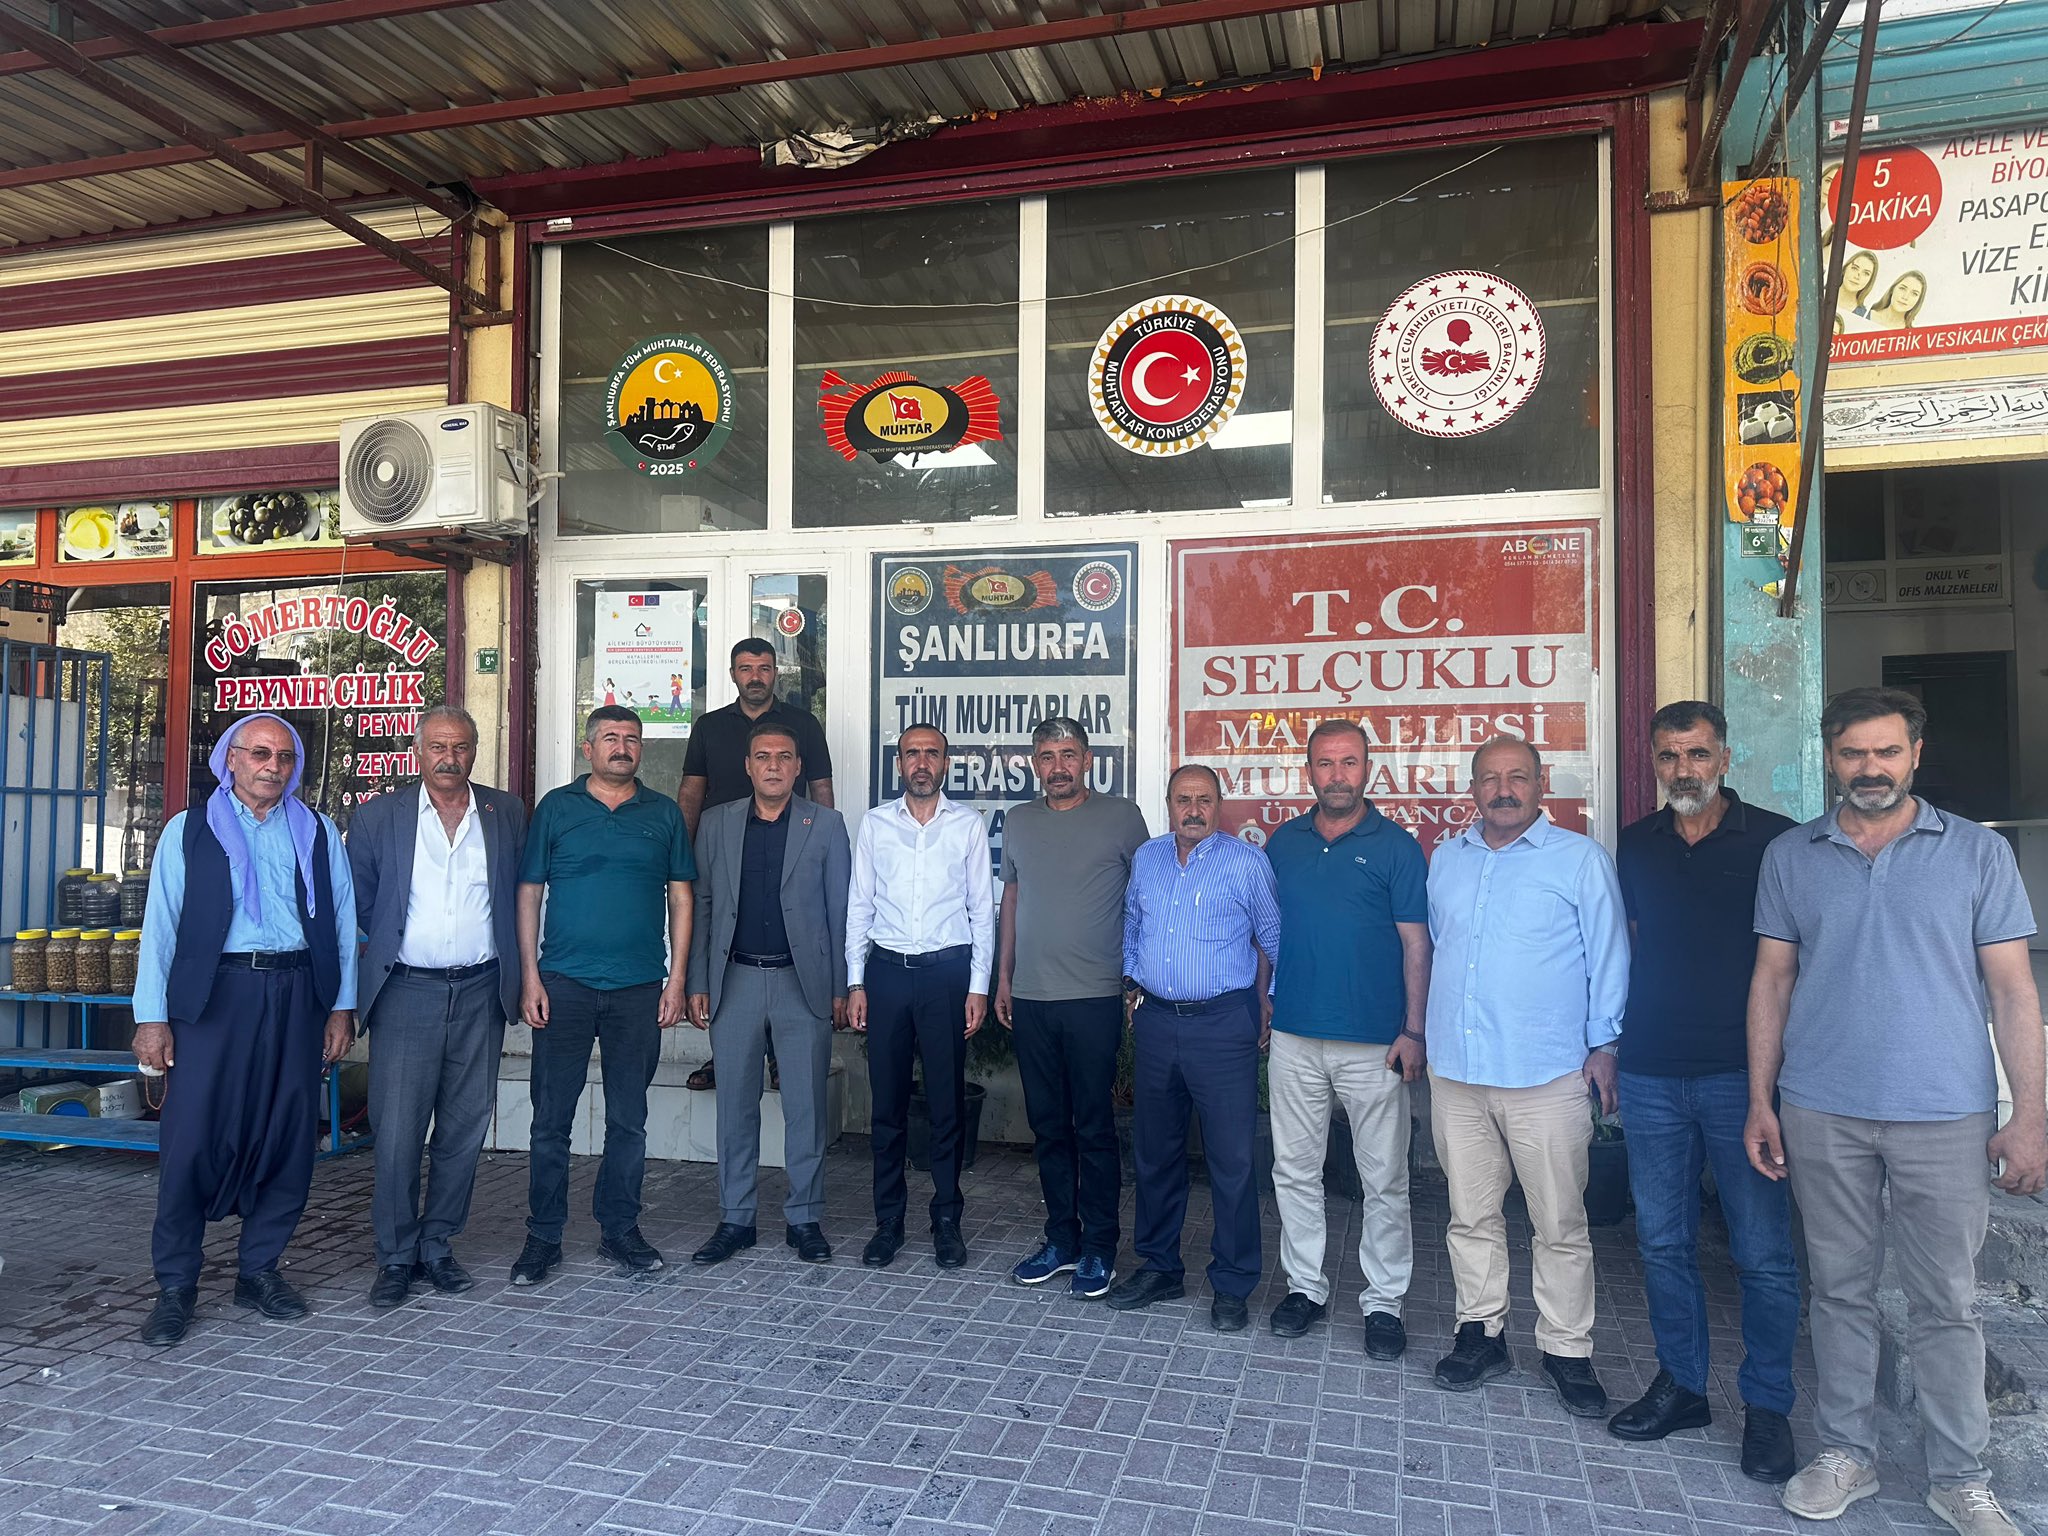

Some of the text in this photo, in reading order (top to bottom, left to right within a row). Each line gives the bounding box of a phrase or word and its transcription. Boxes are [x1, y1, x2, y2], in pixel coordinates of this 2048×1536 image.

[1942, 131, 2016, 160] ACELE
[1873, 158, 1893, 188] 5
[1991, 156, 2048, 184] BİYO
[1848, 192, 1933, 226] DAKİKA
[2029, 223, 2048, 250] E
[1962, 242, 2021, 276] VİZE
[1134, 314, 1197, 337] TÜRKİYE
[1401, 300, 1512, 401] TÜRKİYE CUMHURİYETİ İÇİŞLERİ BAKANLIĞI
[1828, 331, 1923, 358] BİYOMETRİK
[1926, 326, 2009, 349] VESİKALIK
[606, 339, 732, 427] ŞANLIURFA TÜM MUHTARLAR FEDERASYONU
[1105, 346, 1229, 439] MUHTARLAR KONFEDERASYONU
[880, 423, 932, 436] MUHTAR
[650, 463, 684, 476] 2025
[1899, 580, 1999, 597] OFİS MALZEMELERİ
[1925, 569, 1970, 581] OKUL VE
[981, 593, 1015, 603] MUHTAR
[1291, 584, 1465, 638] T.C.
[205, 594, 439, 672] CÖMERTOĞLU
[898, 621, 1110, 672] ŞANLIURFA
[214, 662, 424, 711] PEYNİRCİLİK
[1202, 644, 1564, 704] SELÇUKLU
[358, 707, 424, 737] PEYNİ
[895, 687, 947, 734] TÜM
[356, 746, 420, 776] ZEYTİ
